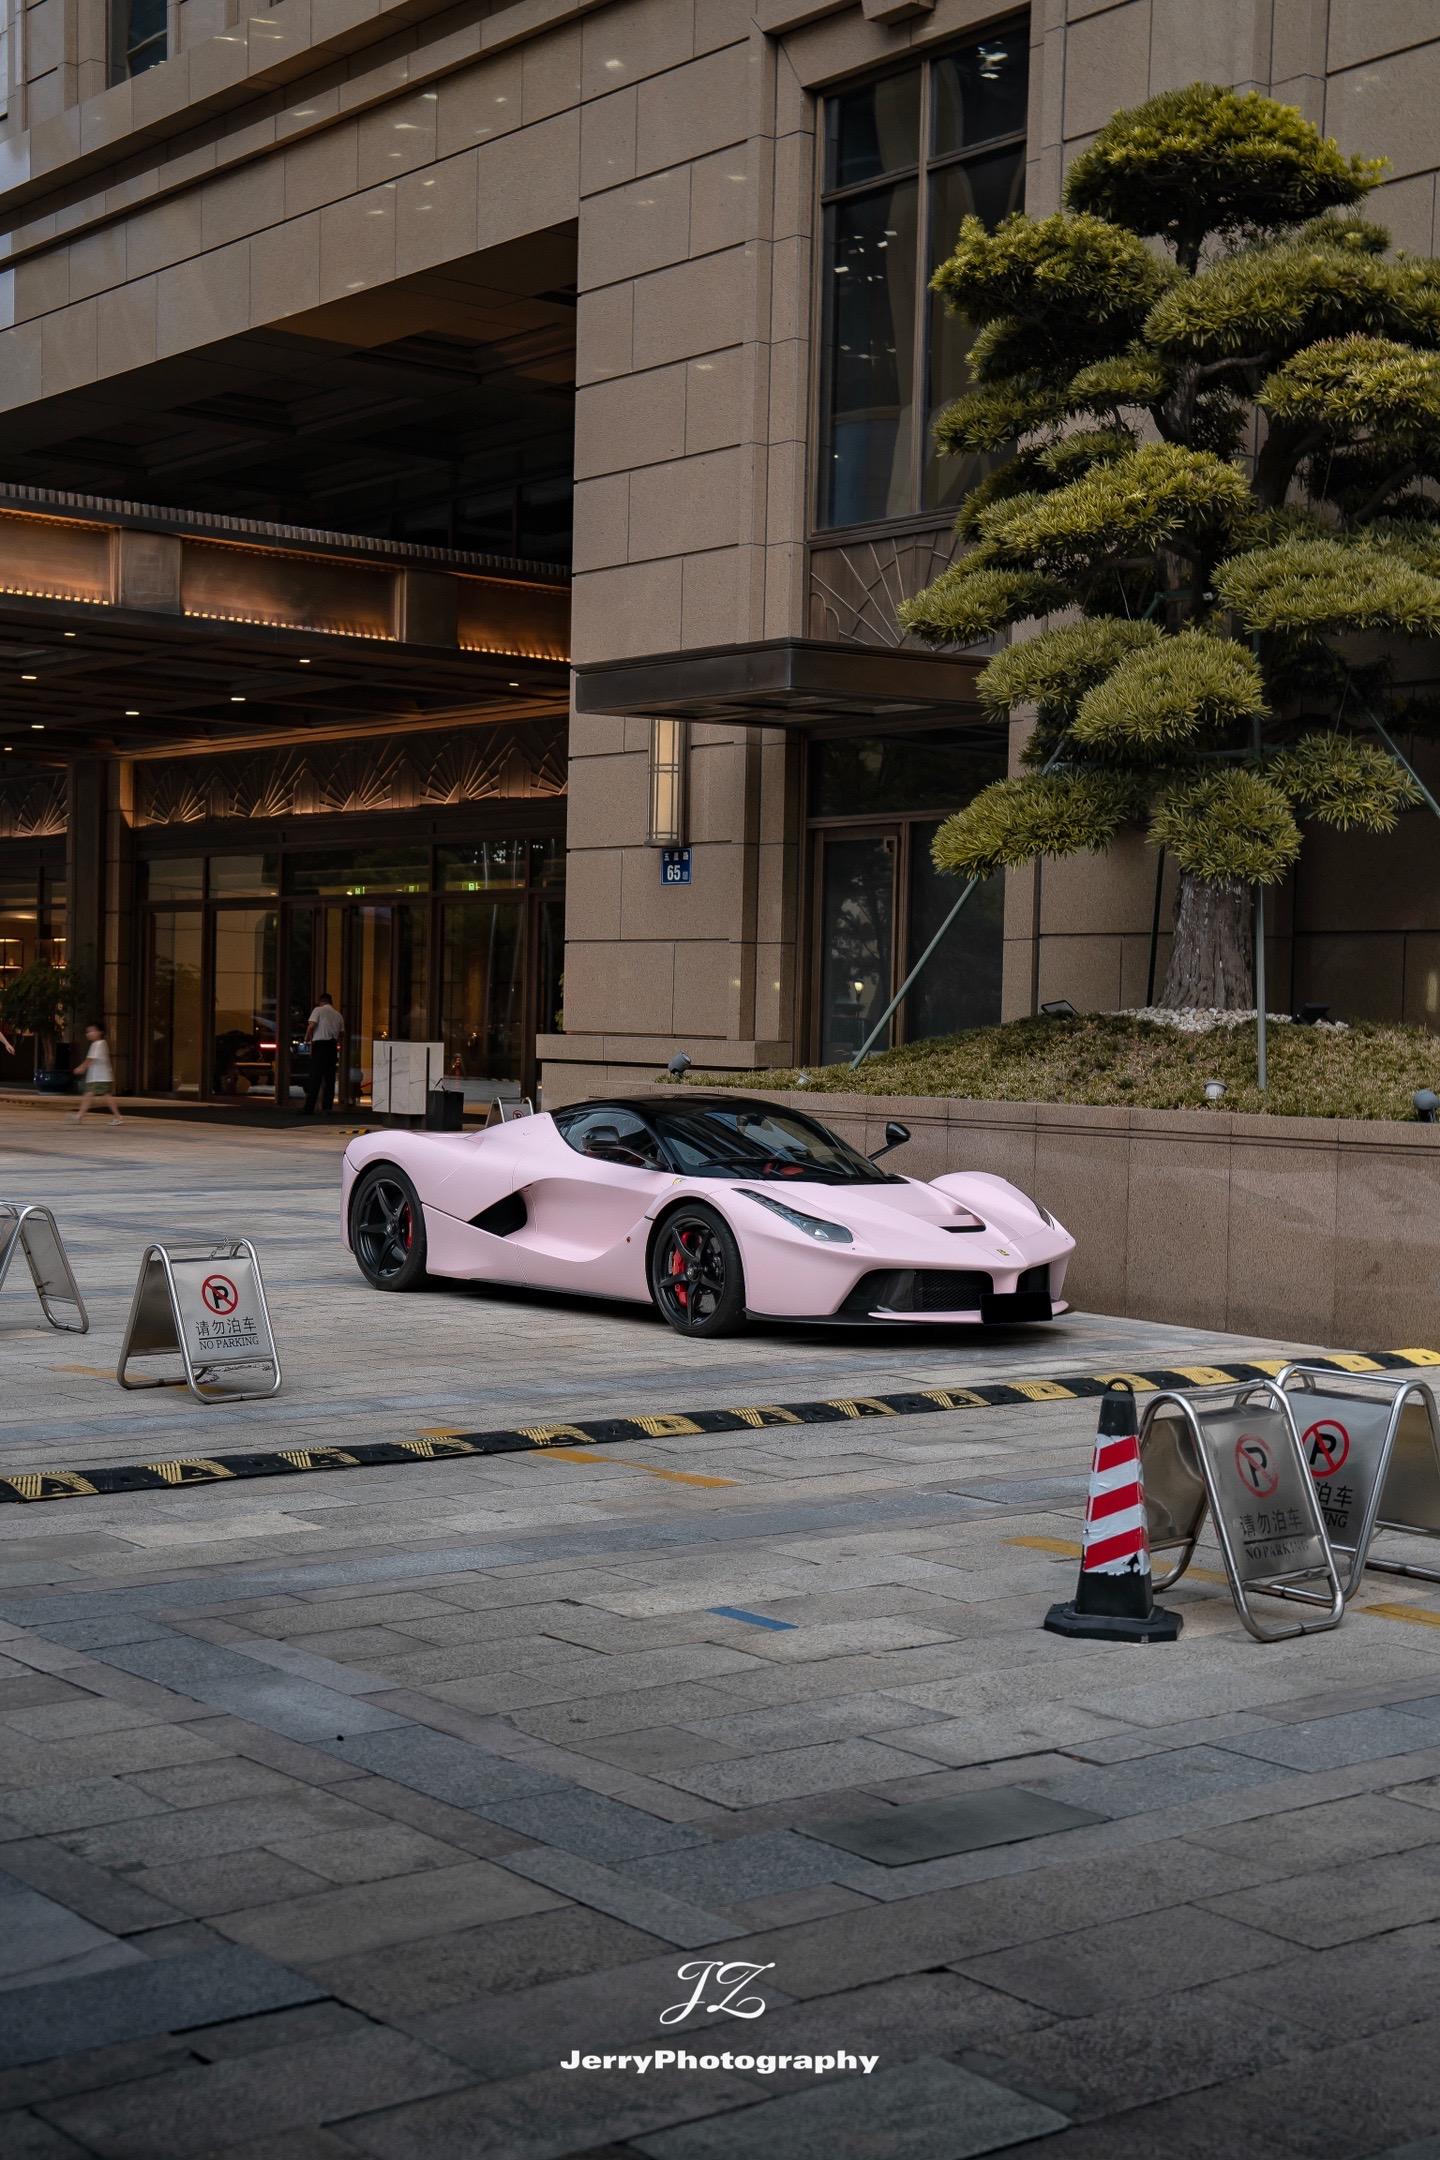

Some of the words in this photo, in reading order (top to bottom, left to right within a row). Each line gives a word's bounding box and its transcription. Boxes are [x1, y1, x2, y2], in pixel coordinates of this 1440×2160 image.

[667, 865, 681, 880] 65
[212, 1286, 229, 1308] P
[195, 1317, 257, 1336] 请勿泊车
[199, 1341, 214, 1350] NO
[216, 1336, 259, 1348] PARKING
[1310, 1434, 1337, 1465] P
[1240, 1508, 1303, 1537] 请勿泊车
